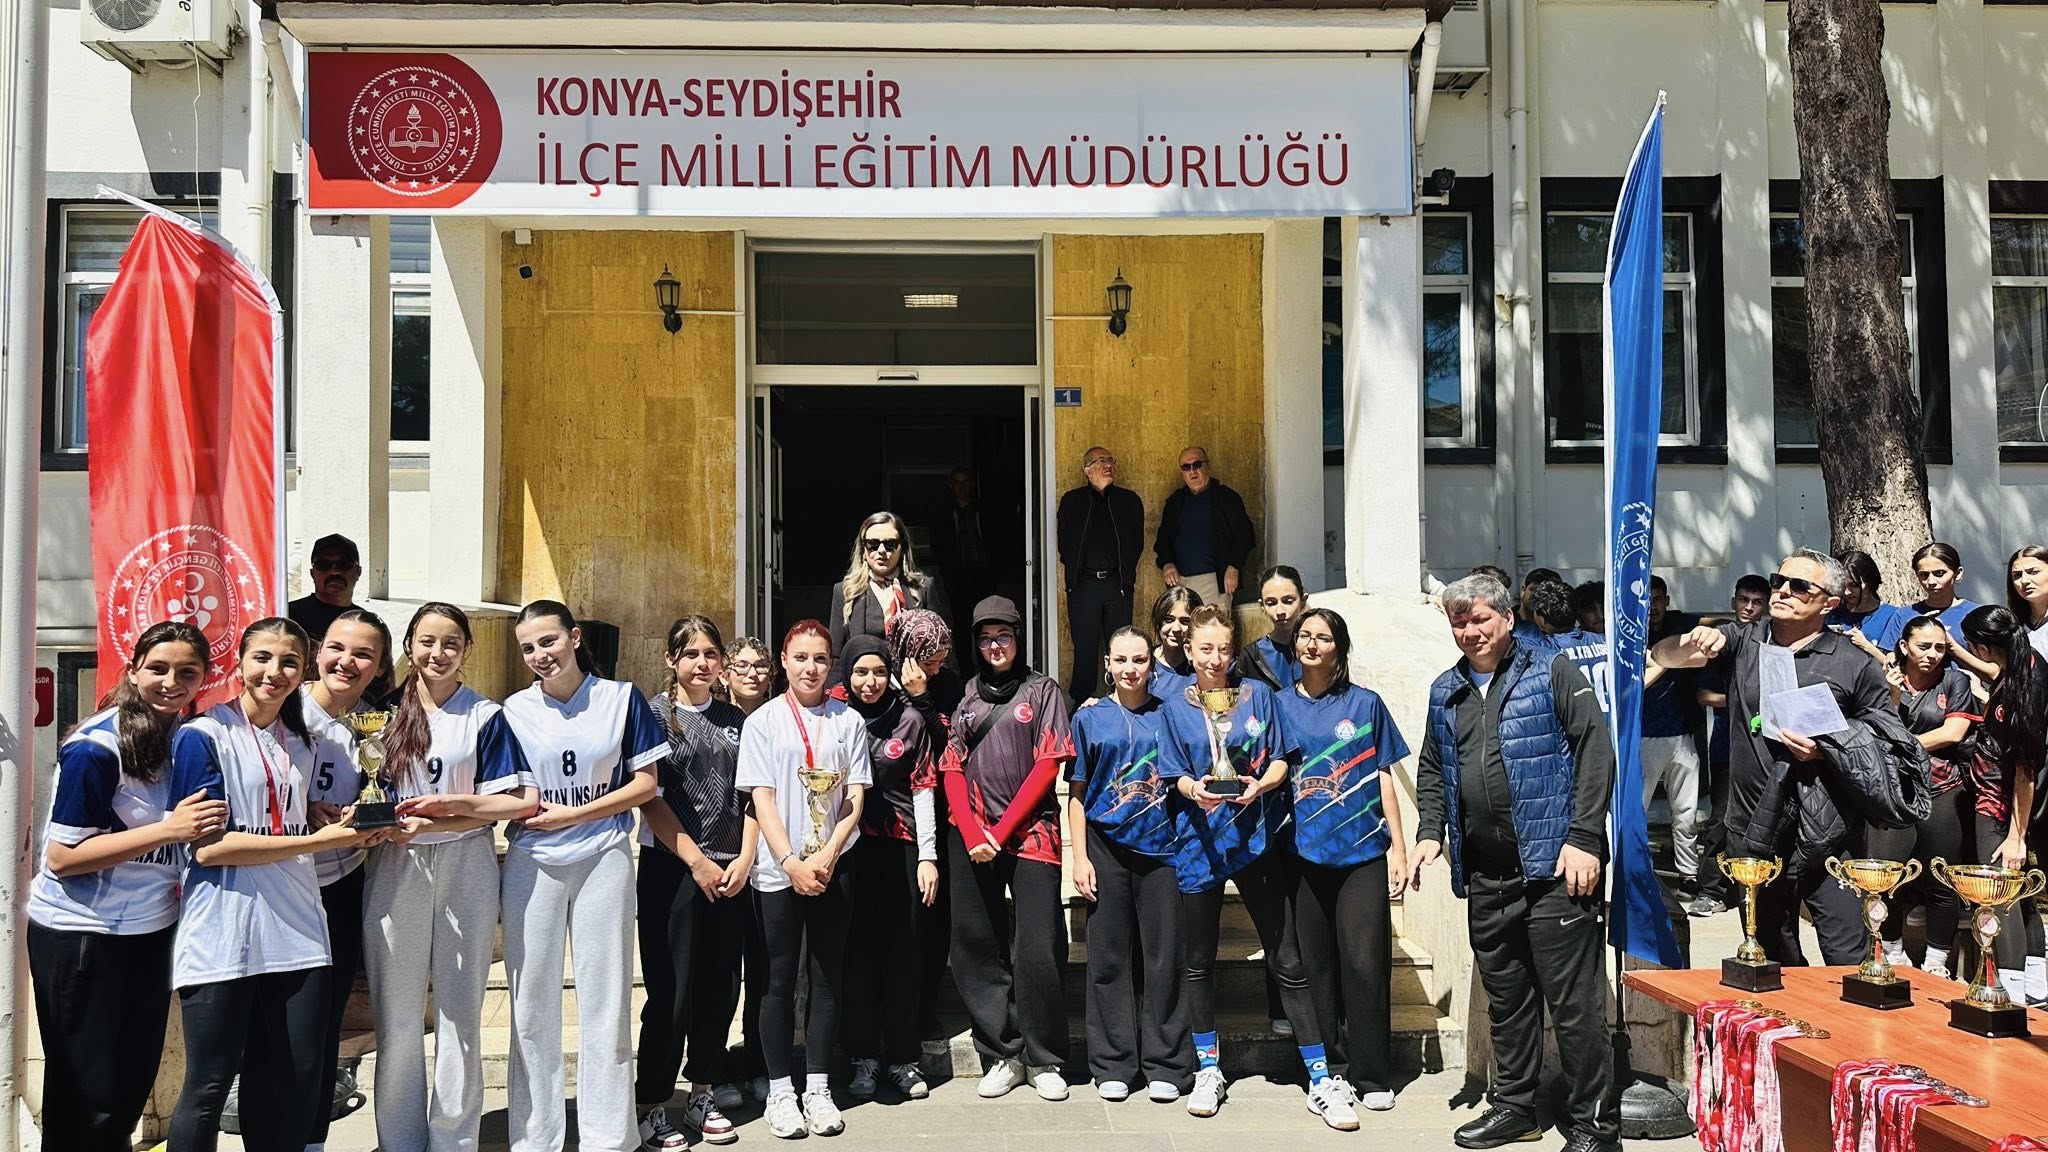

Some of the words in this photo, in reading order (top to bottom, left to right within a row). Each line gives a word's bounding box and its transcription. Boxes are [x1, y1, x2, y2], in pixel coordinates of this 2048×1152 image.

[411, 90, 437, 101] MİLLİ
[536, 69, 902, 127] KONYA-SEYDİŞEHİR
[372, 89, 408, 140] CUMHURİYETİ
[436, 100, 456, 129] EĞİTİM
[375, 142, 405, 171] TÜRKİYE
[424, 131, 456, 171] BAKANLIĞI
[538, 132, 639, 198] İLÇE
[661, 133, 792, 188] MİLLİ
[814, 132, 990, 189] EĞİTİM
[1012, 131, 1350, 189] MÜDÜRLÜĞÜ
[1063, 390, 1071, 403] 1
[316, 761, 335, 792] 5
[427, 757, 443, 784] 9
[562, 750, 577, 777] 8
